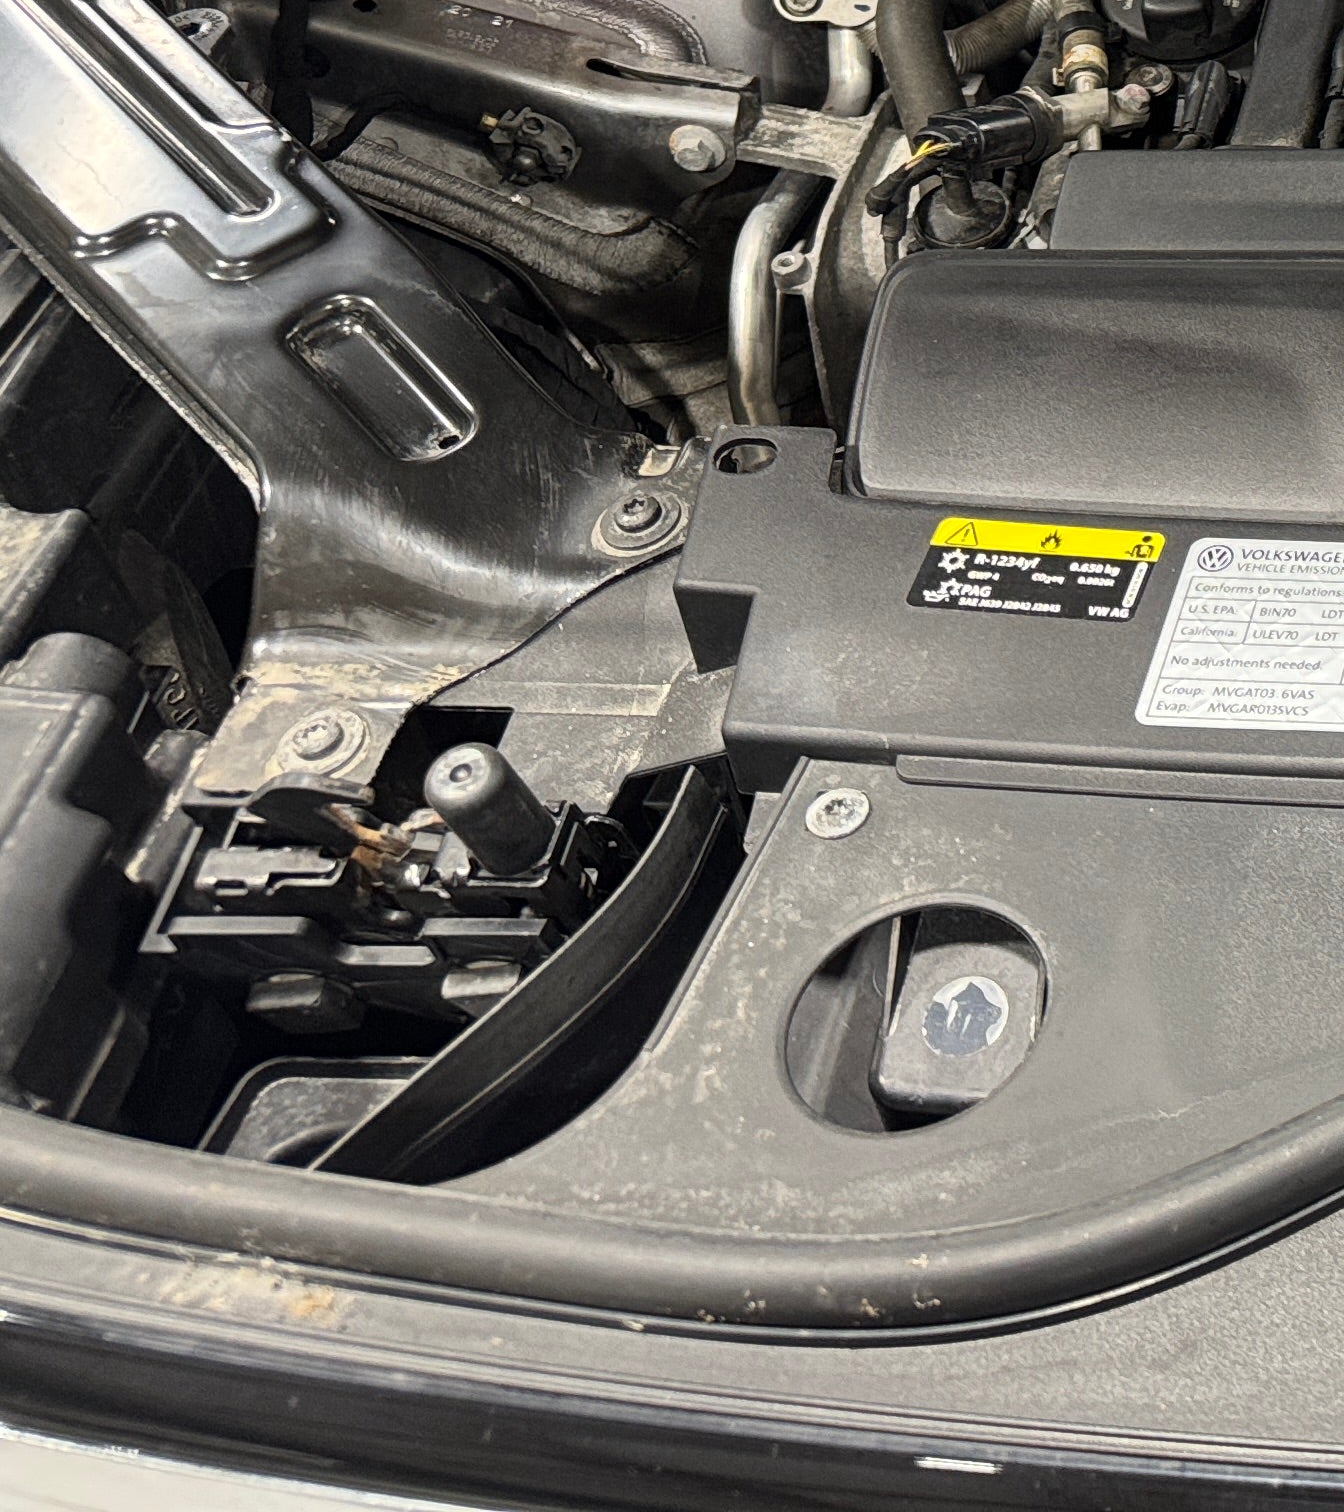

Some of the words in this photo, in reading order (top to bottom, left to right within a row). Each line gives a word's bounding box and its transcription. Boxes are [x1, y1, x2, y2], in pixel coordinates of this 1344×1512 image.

[973, 552, 1041, 571] R-1234yf
[1237, 562, 1287, 574] VEHICLE
[1103, 563, 1121, 578] kg
[961, 584, 992, 598] PAG
[1194, 582, 1255, 595] Conforms
[1257, 585, 1271, 596] to
[1088, 605, 1111, 617] VW
[1108, 607, 1131, 618] AG
[1259, 606, 1297, 618] BIN70
[1251, 629, 1300, 640] ULEV70
[1314, 631, 1340, 642] LDT
[1170, 655, 1190, 666] No
[1191, 656, 1271, 669] adjustments
